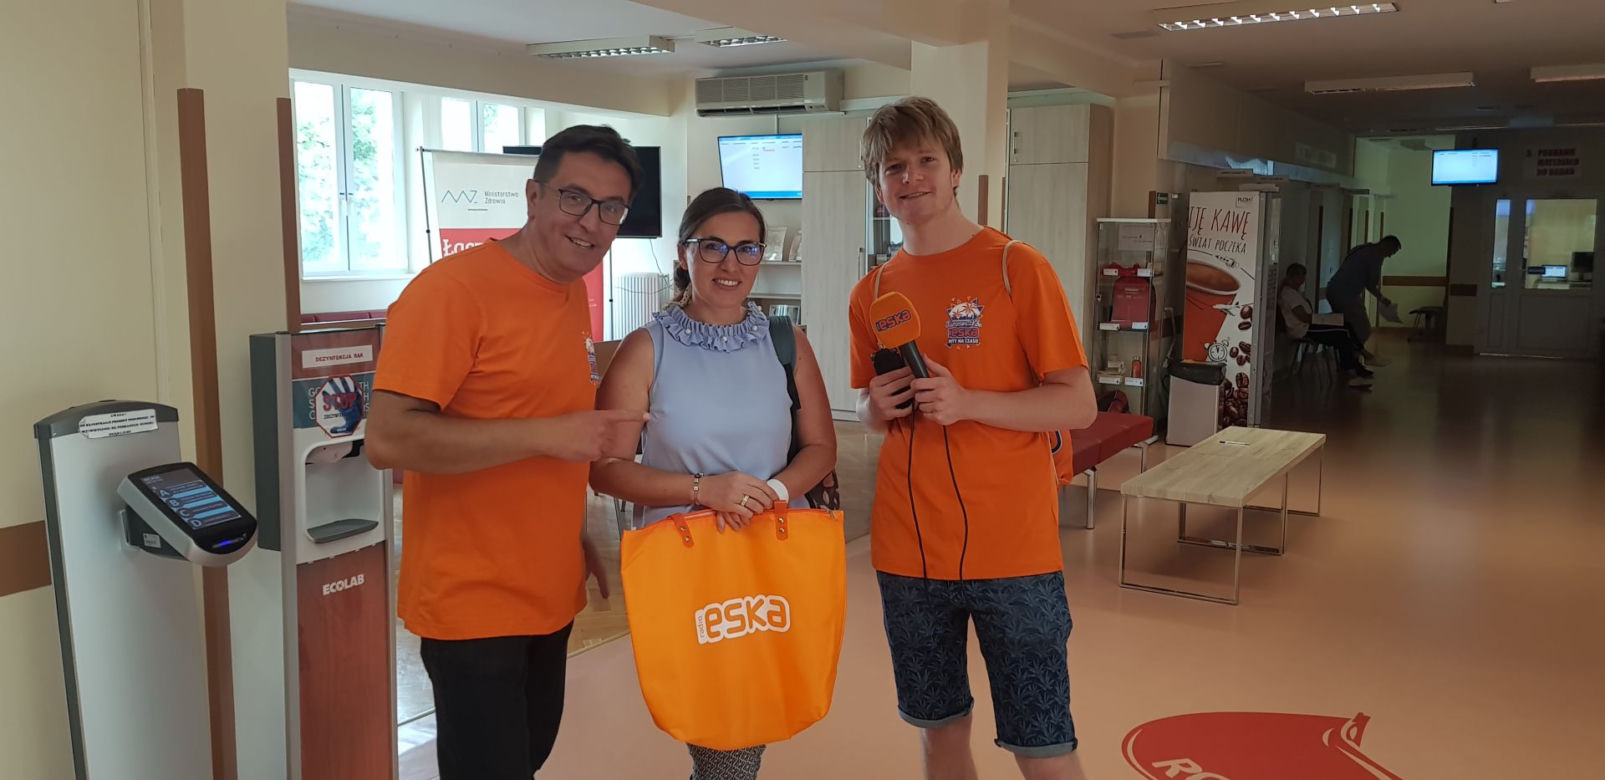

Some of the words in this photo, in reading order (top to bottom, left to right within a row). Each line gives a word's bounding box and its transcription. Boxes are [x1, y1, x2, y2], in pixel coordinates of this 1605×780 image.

[1211, 208, 1251, 240] KAWĘ
[1189, 234, 1212, 249] ŚWIAT
[1214, 239, 1247, 254] POCZEKA
[879, 310, 911, 330] eska
[951, 328, 978, 337] eska
[323, 391, 357, 411] STOP
[322, 573, 365, 596] ECOLAB
[696, 614, 705, 640] radio
[704, 597, 789, 640] eska
